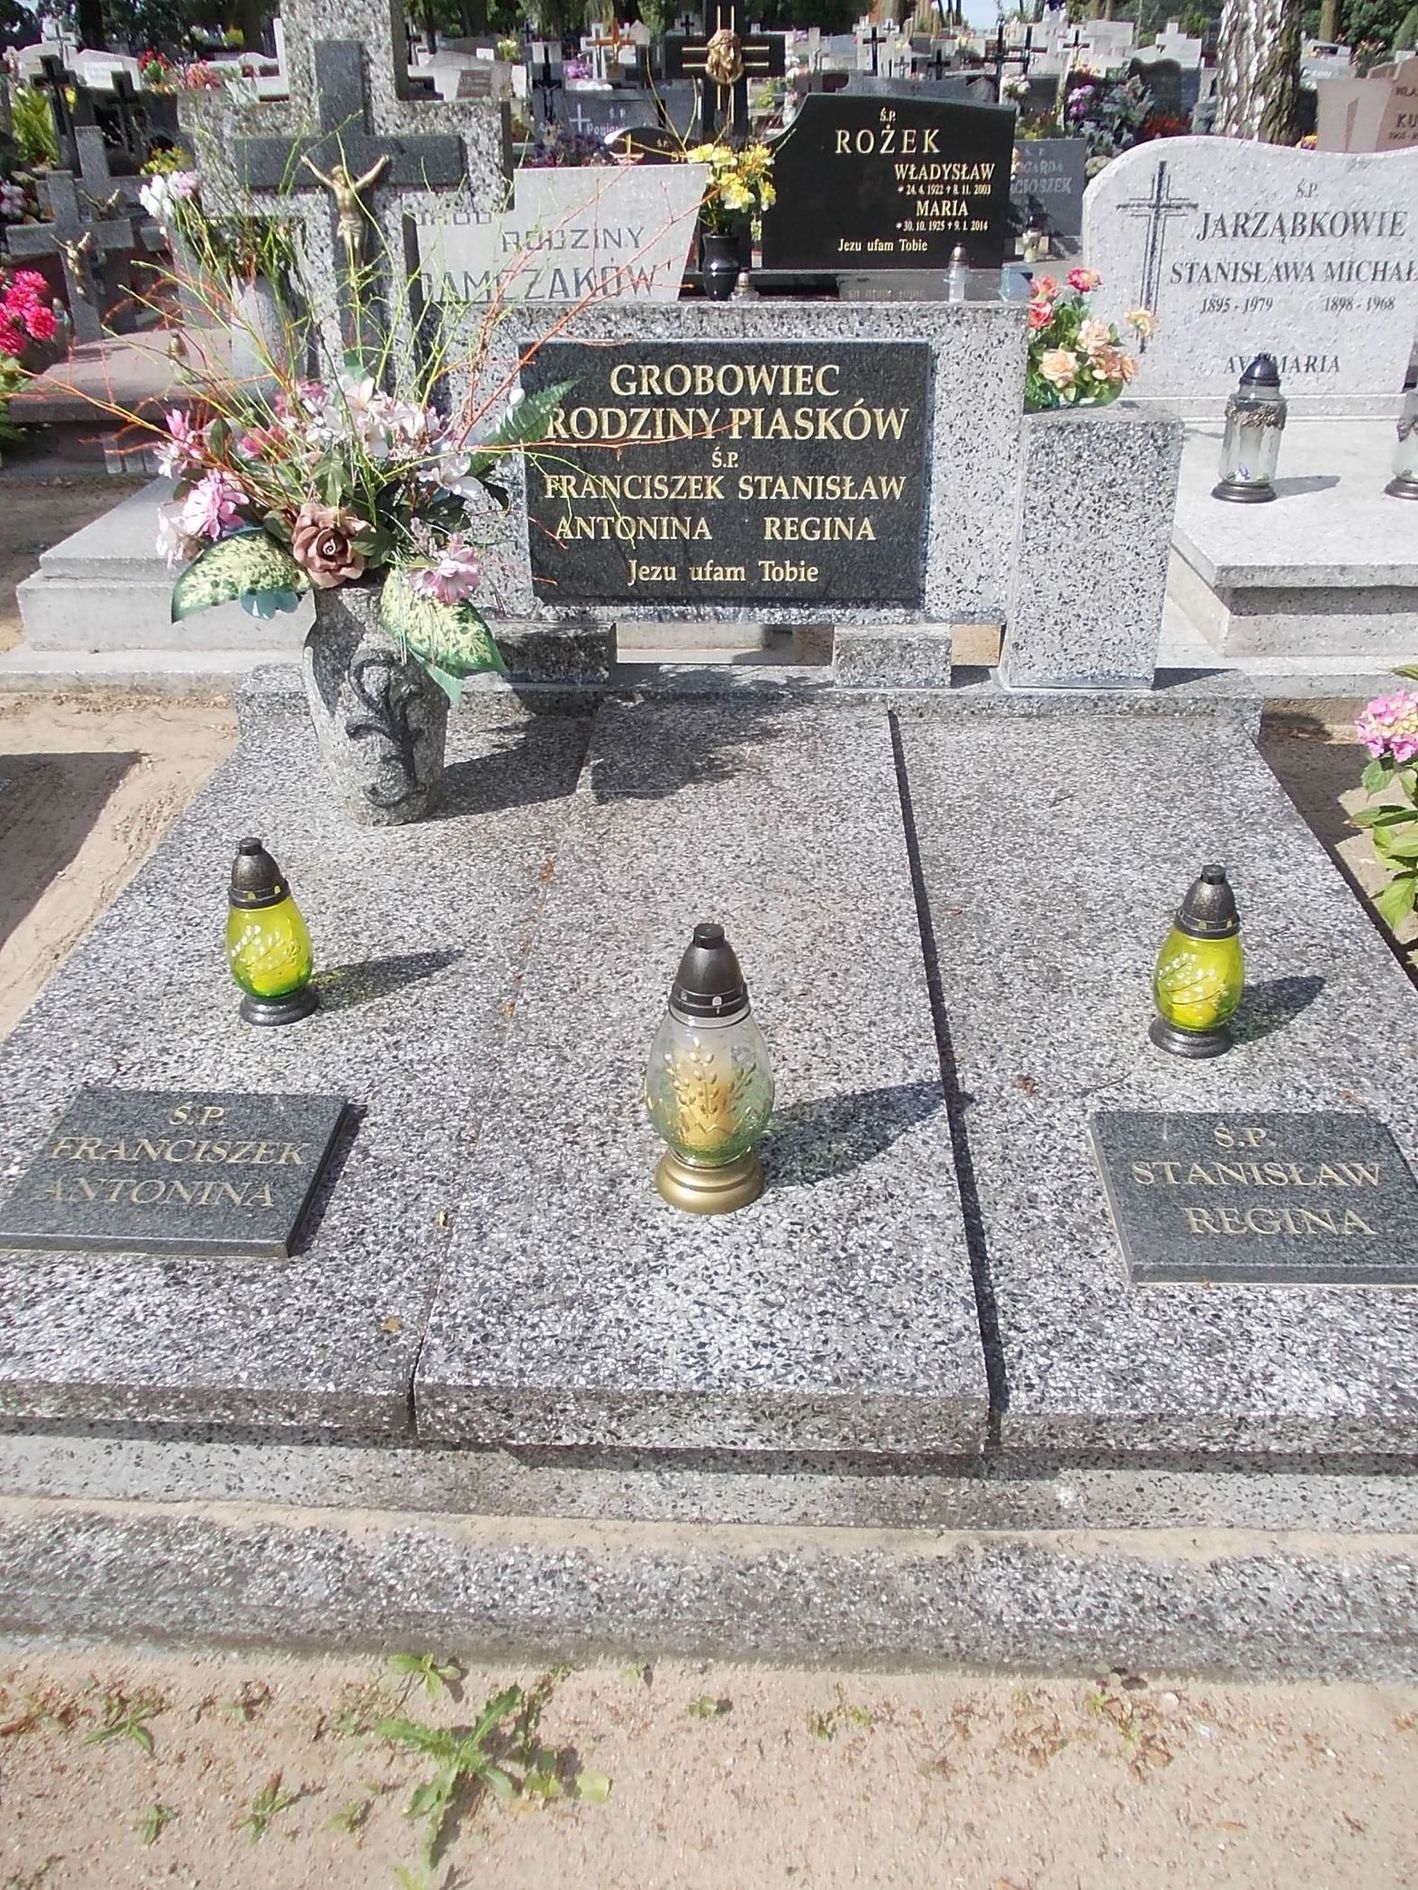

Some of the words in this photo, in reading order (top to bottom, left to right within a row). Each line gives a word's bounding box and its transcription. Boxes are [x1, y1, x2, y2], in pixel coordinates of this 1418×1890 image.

[835, 124, 940, 154] ROŻEK
[894, 163, 996, 181] WŁADYSŁAW
[927, 184, 944, 195] 1922
[973, 184, 991, 195] 2003
[916, 200, 968, 216] MARIA
[928, 220, 945, 231] 1925
[970, 220, 988, 231] 2014
[1196, 210, 1408, 245] JARZĄBKOWIE
[837, 238, 862, 252] Jezu
[867, 238, 894, 252] ufam
[899, 238, 928, 252] Tobie
[1170, 259, 1315, 284] STANISŁAWA
[1200, 297, 1231, 315] 1895
[1242, 297, 1274, 314] 1979
[1324, 296, 1354, 317] 1898
[1366, 296, 1396, 312] 1968
[610, 363, 841, 397] GROBOWIEC
[545, 406, 722, 441] RODZINY
[729, 398, 910, 442] PIASKÓW
[711, 447, 739, 469] Ś.P.
[544, 474, 725, 500] FRANCISZEK
[737, 474, 907, 500] STANISŁAW
[555, 516, 713, 541] ANTONINA
[763, 516, 877, 542] REGINA
[627, 559, 677, 587] Jezu
[688, 560, 747, 583] ufam
[758, 560, 819, 583] Tobie
[49, 1136, 312, 1166] FRANCISZEK
[1132, 1161, 1381, 1187] STANISŁAW
[45, 1174, 274, 1207] ANTONINA
[1181, 1207, 1377, 1235] REGINA
